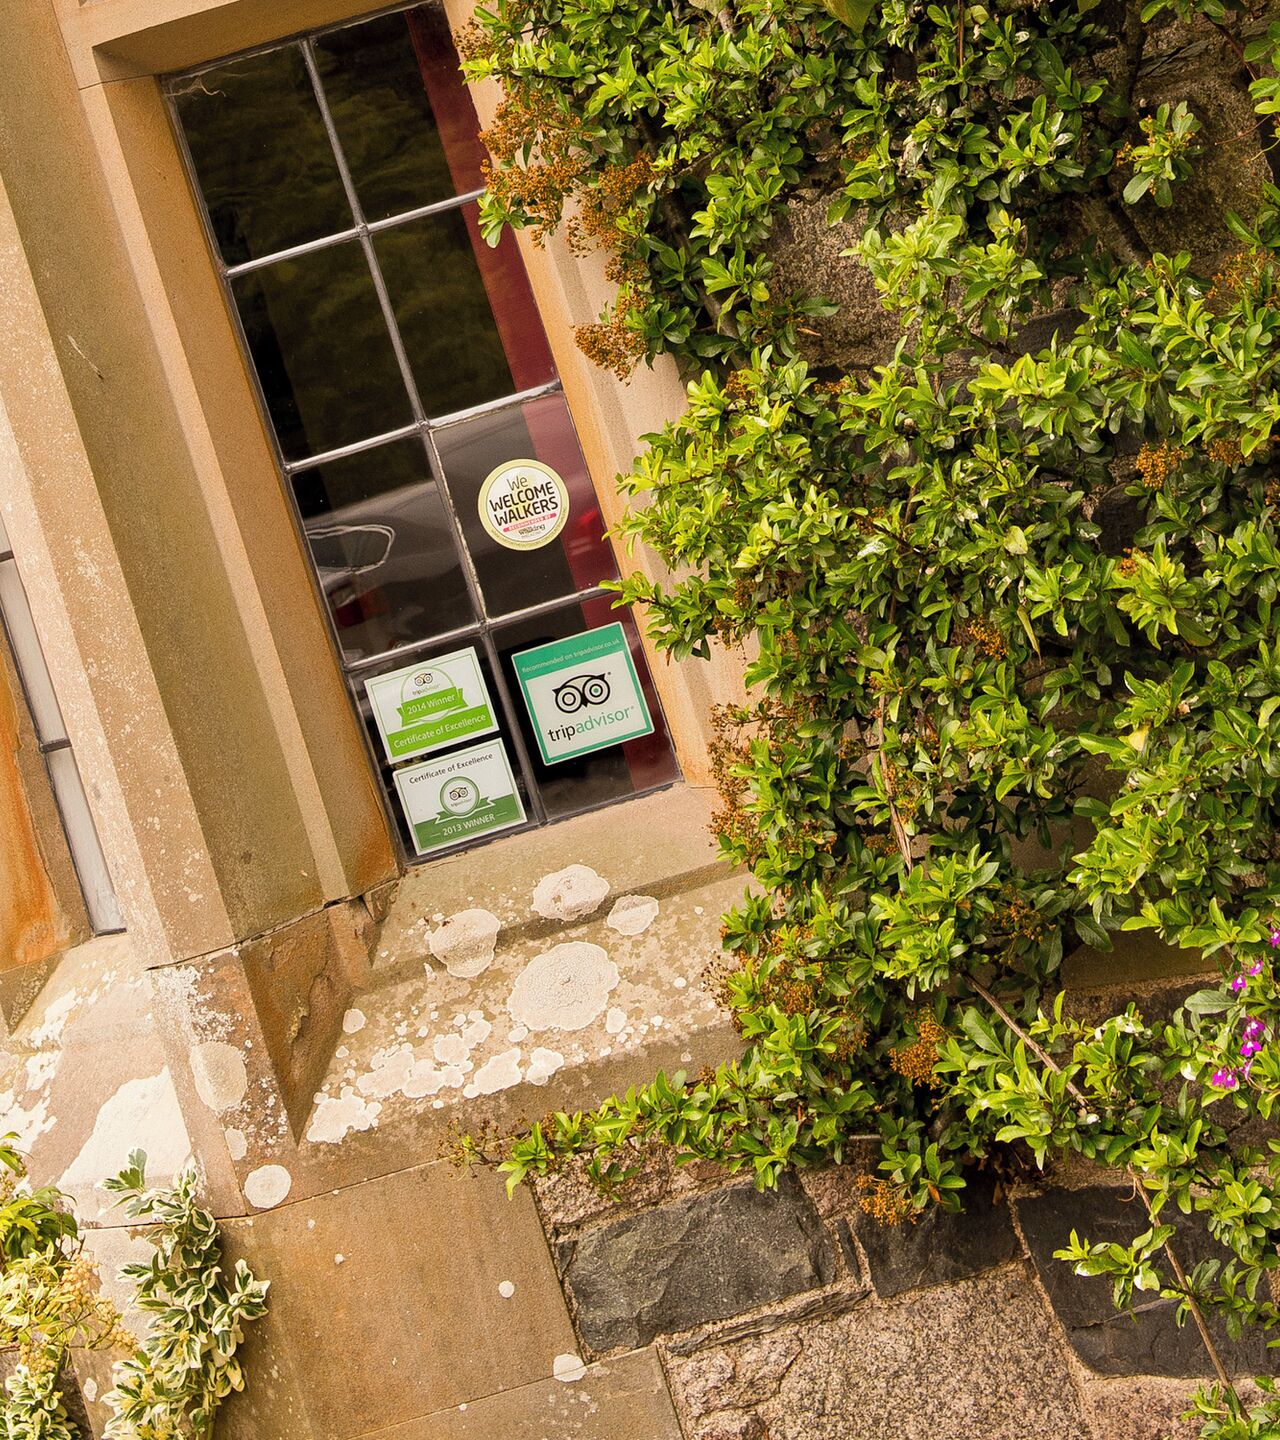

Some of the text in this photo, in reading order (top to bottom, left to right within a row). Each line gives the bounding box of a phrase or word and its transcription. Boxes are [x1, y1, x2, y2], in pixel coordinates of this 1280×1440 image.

[489, 481, 555, 512] WELCOME
[507, 476, 528, 491] We
[494, 496, 558, 526] WALKERS
[521, 639, 620, 673] Recommended on tripadvisor.co.uk
[407, 694, 455, 715] 2014 Winner
[393, 714, 486, 748] Certificate of Excellence
[548, 707, 630, 741] tripadvisor
[409, 753, 493, 784] Certificate of Excellence
[442, 813, 495, 836] 2013 WINNER
